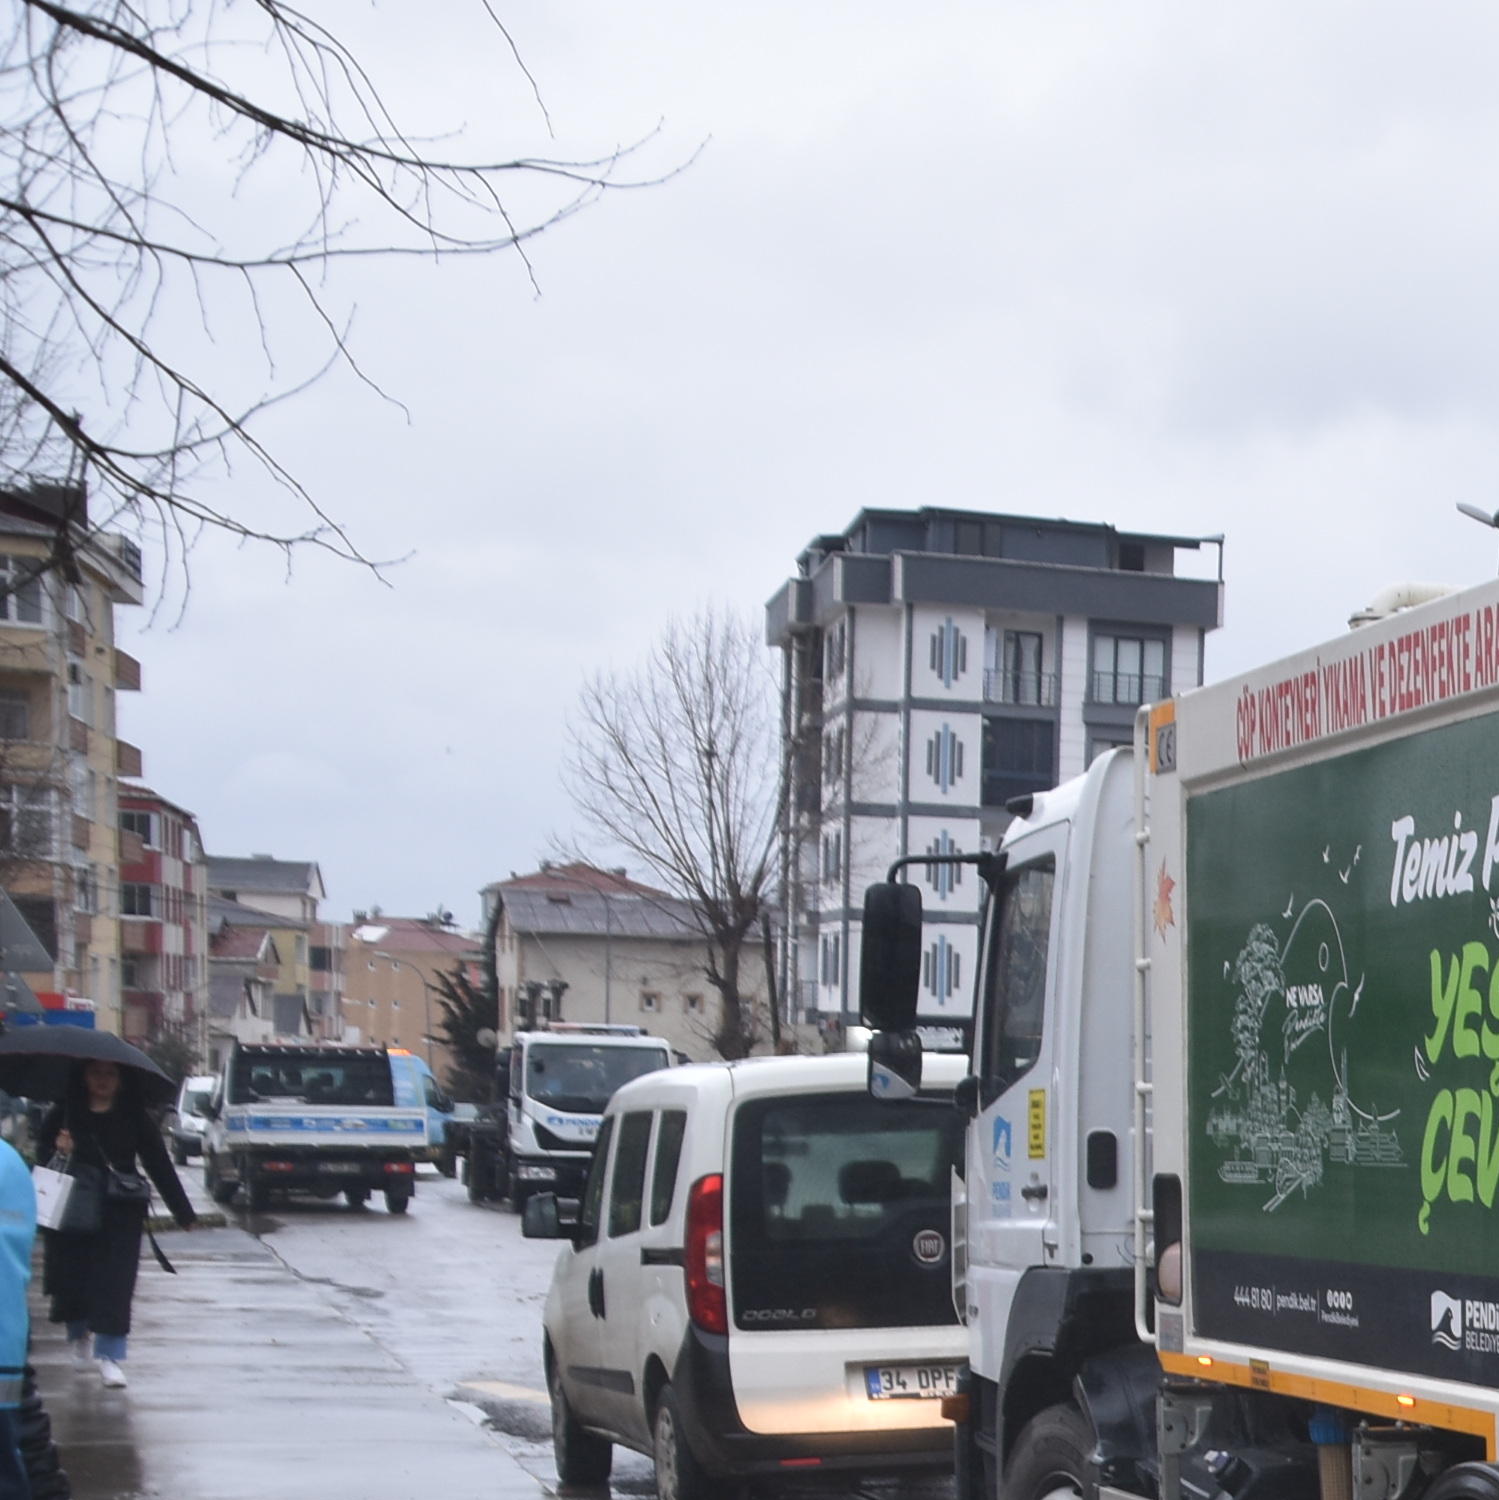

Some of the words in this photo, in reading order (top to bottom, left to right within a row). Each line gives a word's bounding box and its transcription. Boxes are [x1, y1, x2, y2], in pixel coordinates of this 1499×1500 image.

[1258, 655, 1322, 756] KONTEYNERİ
[1322, 651, 1368, 735] YIKAMA
[1368, 643, 1386, 720] VE
[1388, 612, 1471, 716] DEZENFEKTE
[1390, 810, 1478, 908] Temiz
[919, 1238, 939, 1254] FIAT
[1233, 1285, 1251, 1307] 444
[1260, 1287, 1273, 1311] 80
[881, 1369, 907, 1391] 34
[917, 1368, 955, 1389] DPF
